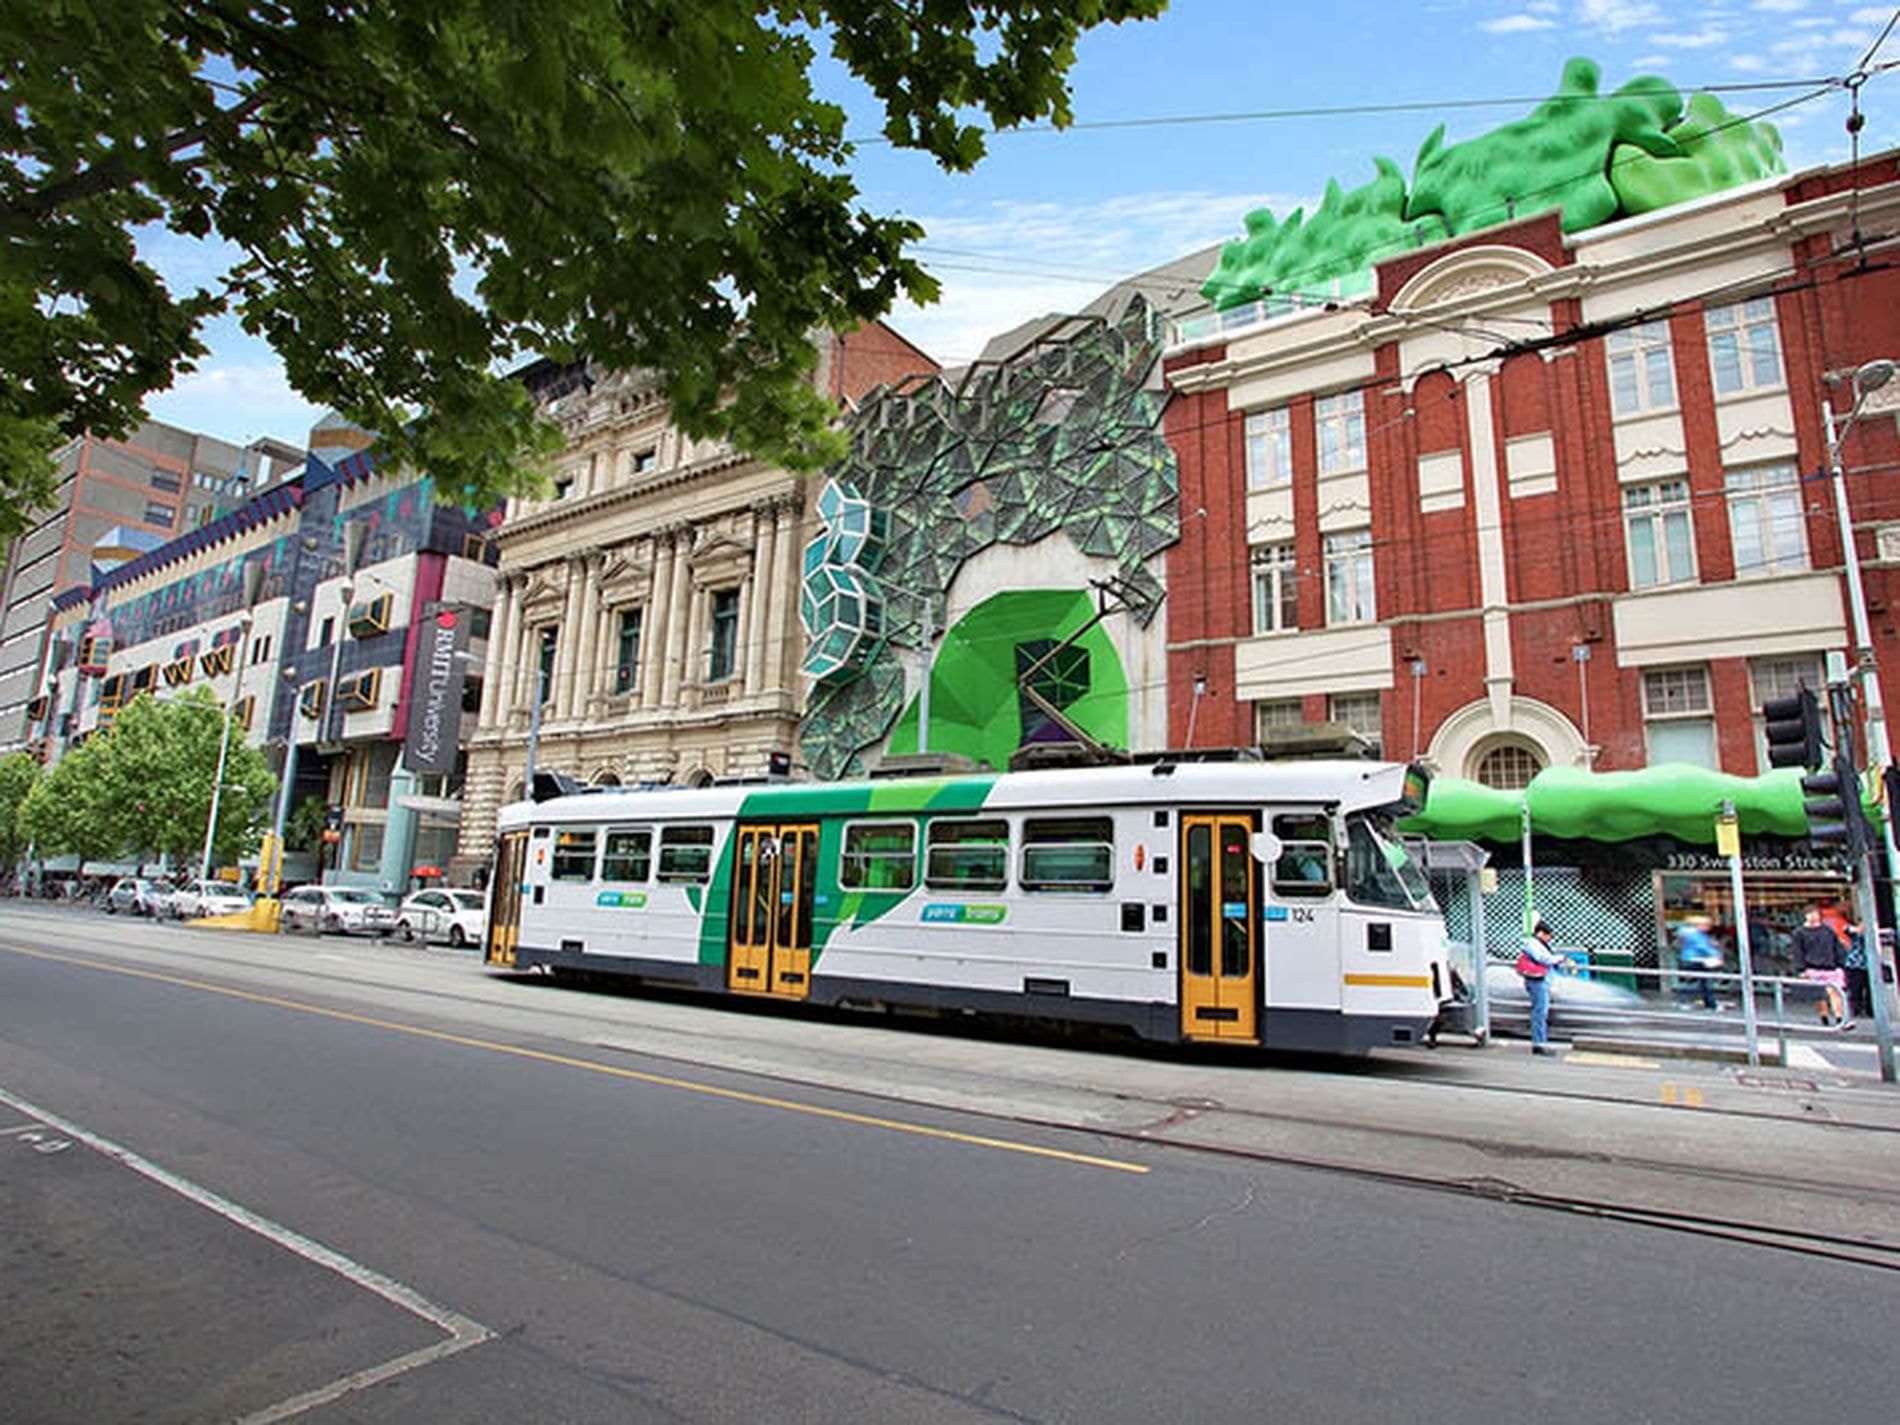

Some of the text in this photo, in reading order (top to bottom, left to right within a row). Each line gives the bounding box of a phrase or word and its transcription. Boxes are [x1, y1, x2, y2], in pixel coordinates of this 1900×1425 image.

[415, 628, 454, 763] RMIT University
[1668, 854, 1697, 869] 330
[1701, 854, 1781, 869] Swaston
[1292, 907, 1315, 922] 124
